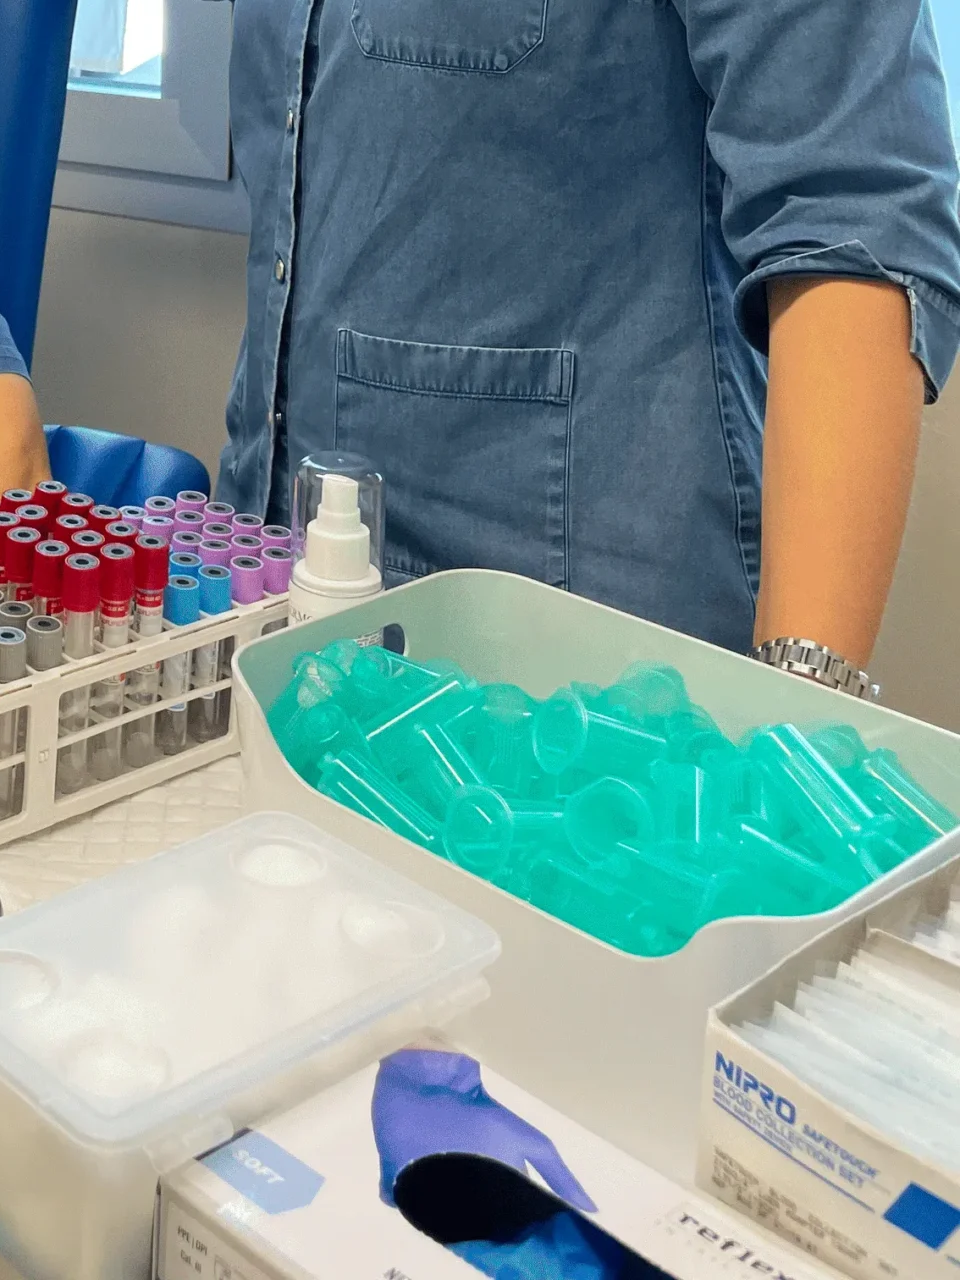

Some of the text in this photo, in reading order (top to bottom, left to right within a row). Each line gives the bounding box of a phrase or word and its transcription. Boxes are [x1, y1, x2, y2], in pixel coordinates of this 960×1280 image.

[714, 1050, 796, 1125] NIPRO
[233, 1149, 286, 1184] SOFT
[713, 1075, 864, 1189] BLOOD COLLECTION SET
